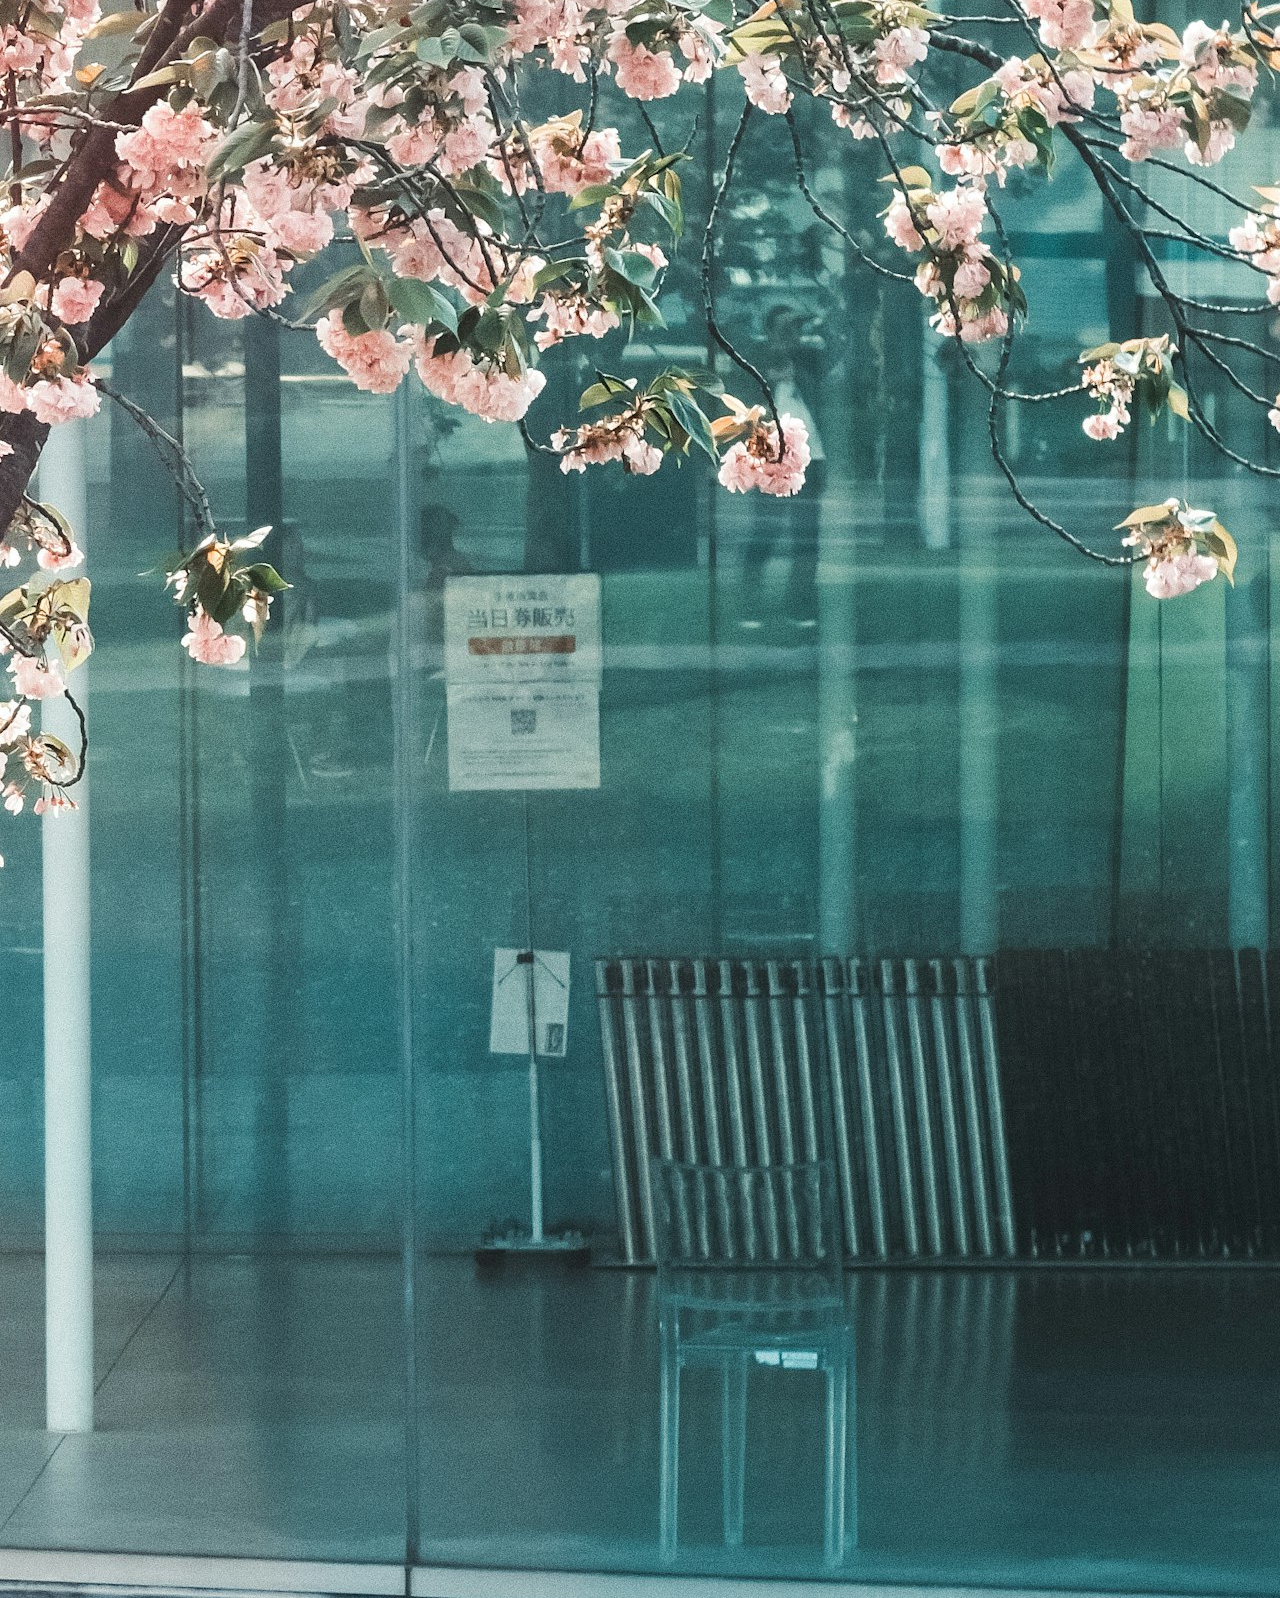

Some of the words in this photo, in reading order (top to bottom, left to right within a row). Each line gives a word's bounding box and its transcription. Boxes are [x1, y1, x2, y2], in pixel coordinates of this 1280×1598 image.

[468, 606, 575, 629] 当日券販売
